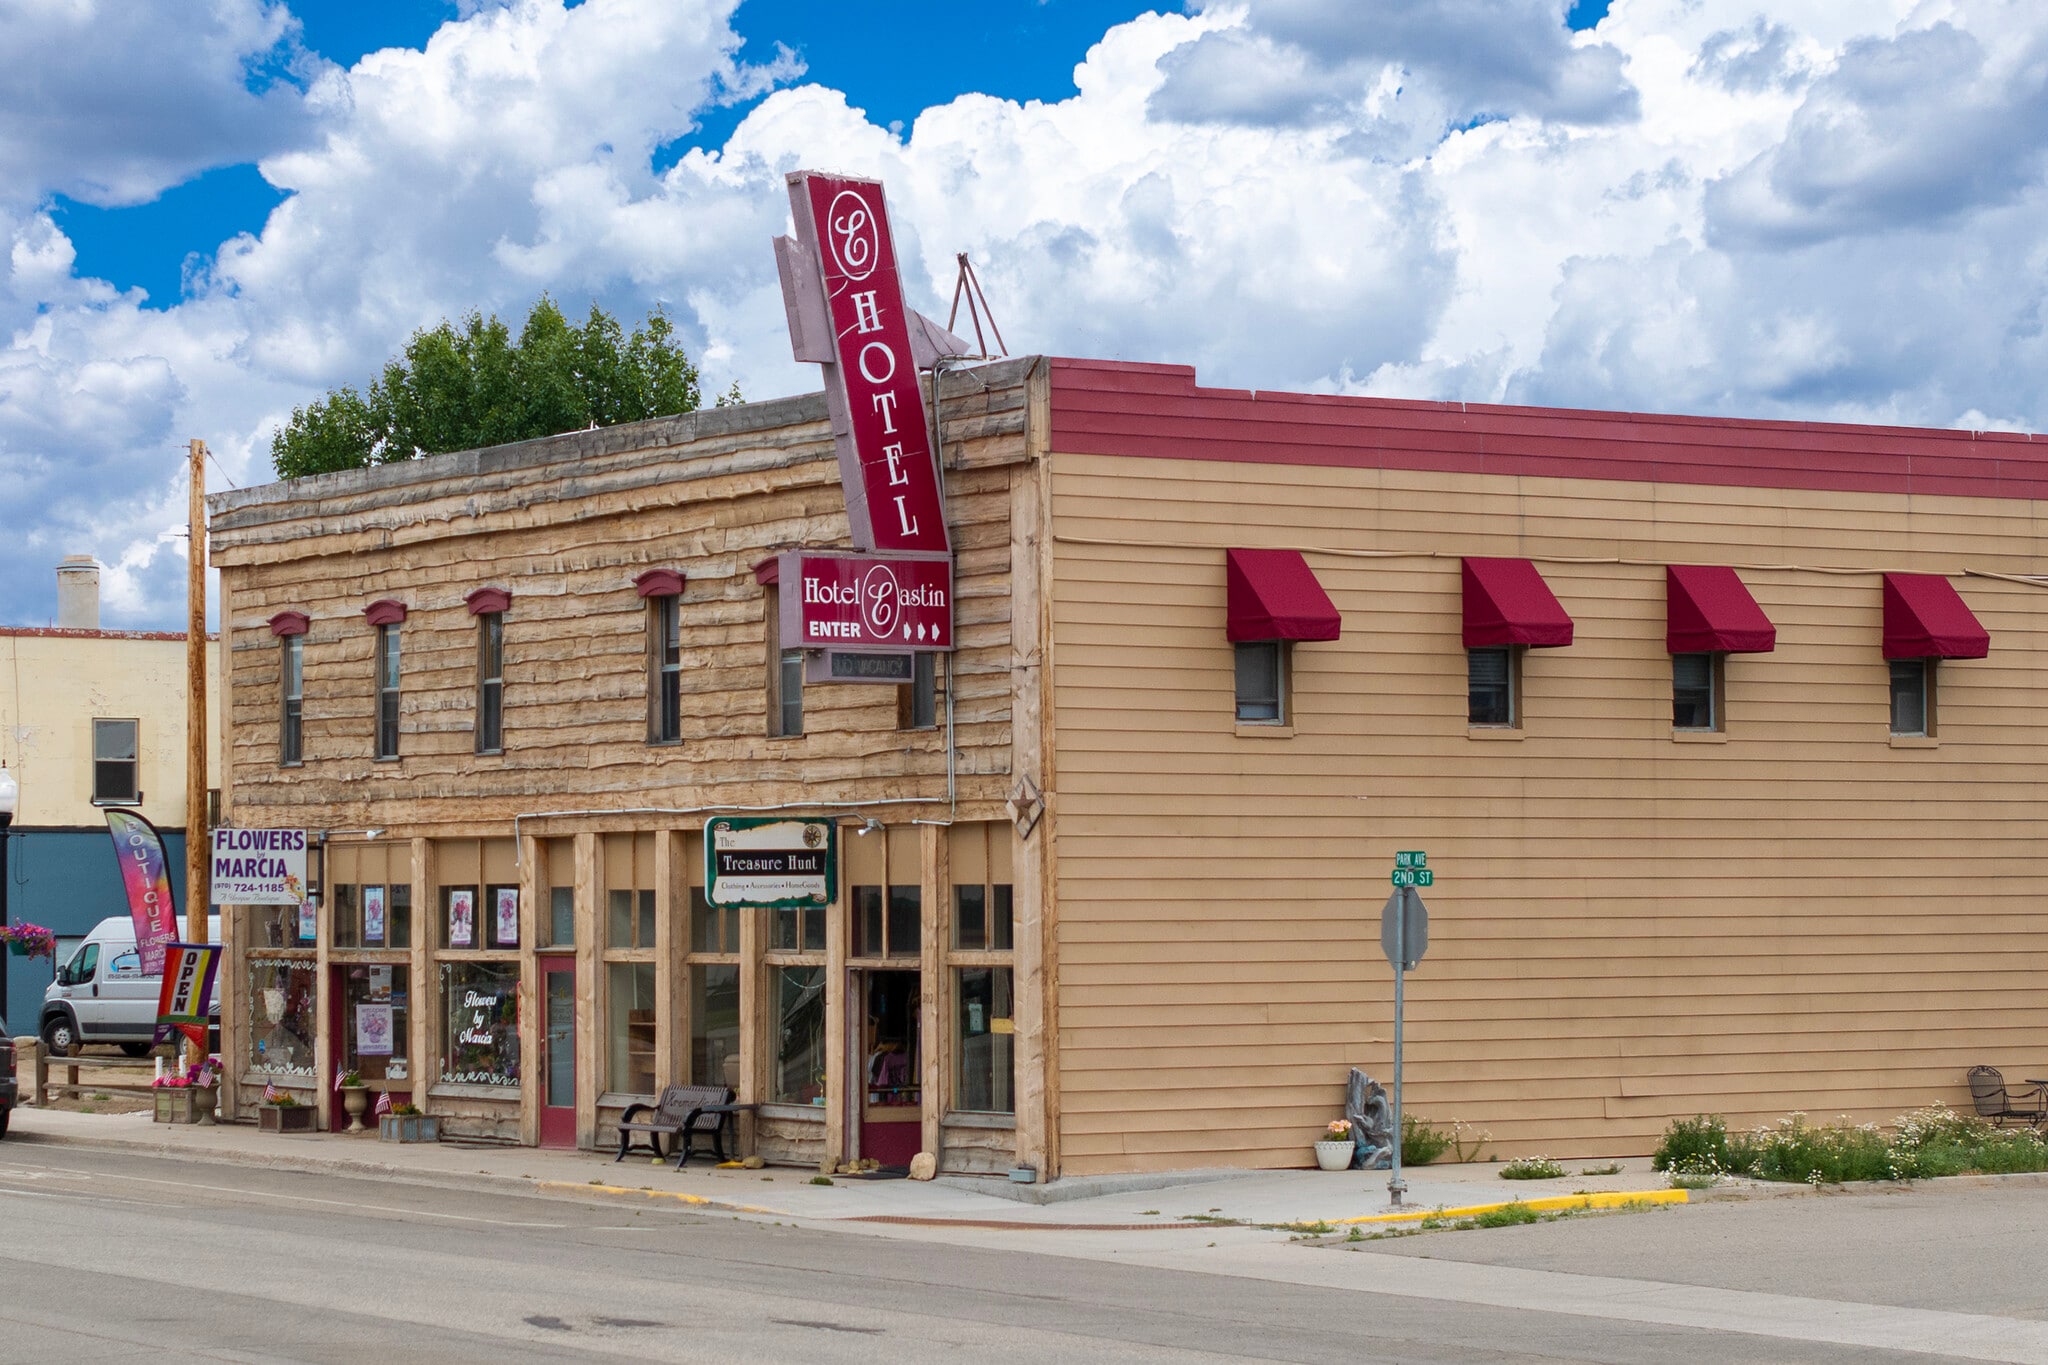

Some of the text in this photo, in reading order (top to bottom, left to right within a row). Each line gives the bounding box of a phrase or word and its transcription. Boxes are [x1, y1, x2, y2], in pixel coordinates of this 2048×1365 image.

[851, 290, 919, 537] HOTEL
[804, 577, 860, 604] Hotel
[809, 621, 861, 638] ENTER
[858, 659, 905, 676] VACANCY
[216, 830, 304, 850] FLOWERS
[720, 836, 736, 848] The
[215, 858, 287, 878] MARCIA
[723, 854, 818, 871] Treasure Hunt
[1396, 853, 1426, 866] PARK AVE
[125, 821, 162, 933] BOUTIQUE
[1394, 871, 1431, 884] 2ND ST
[233, 883, 284, 892] 724-1185
[140, 931, 175, 947] FLOWERS
[173, 951, 198, 1013] OPEN
[463, 990, 497, 1008] Flowers
[472, 1009, 485, 1029] by
[459, 1027, 493, 1045] Marcia
